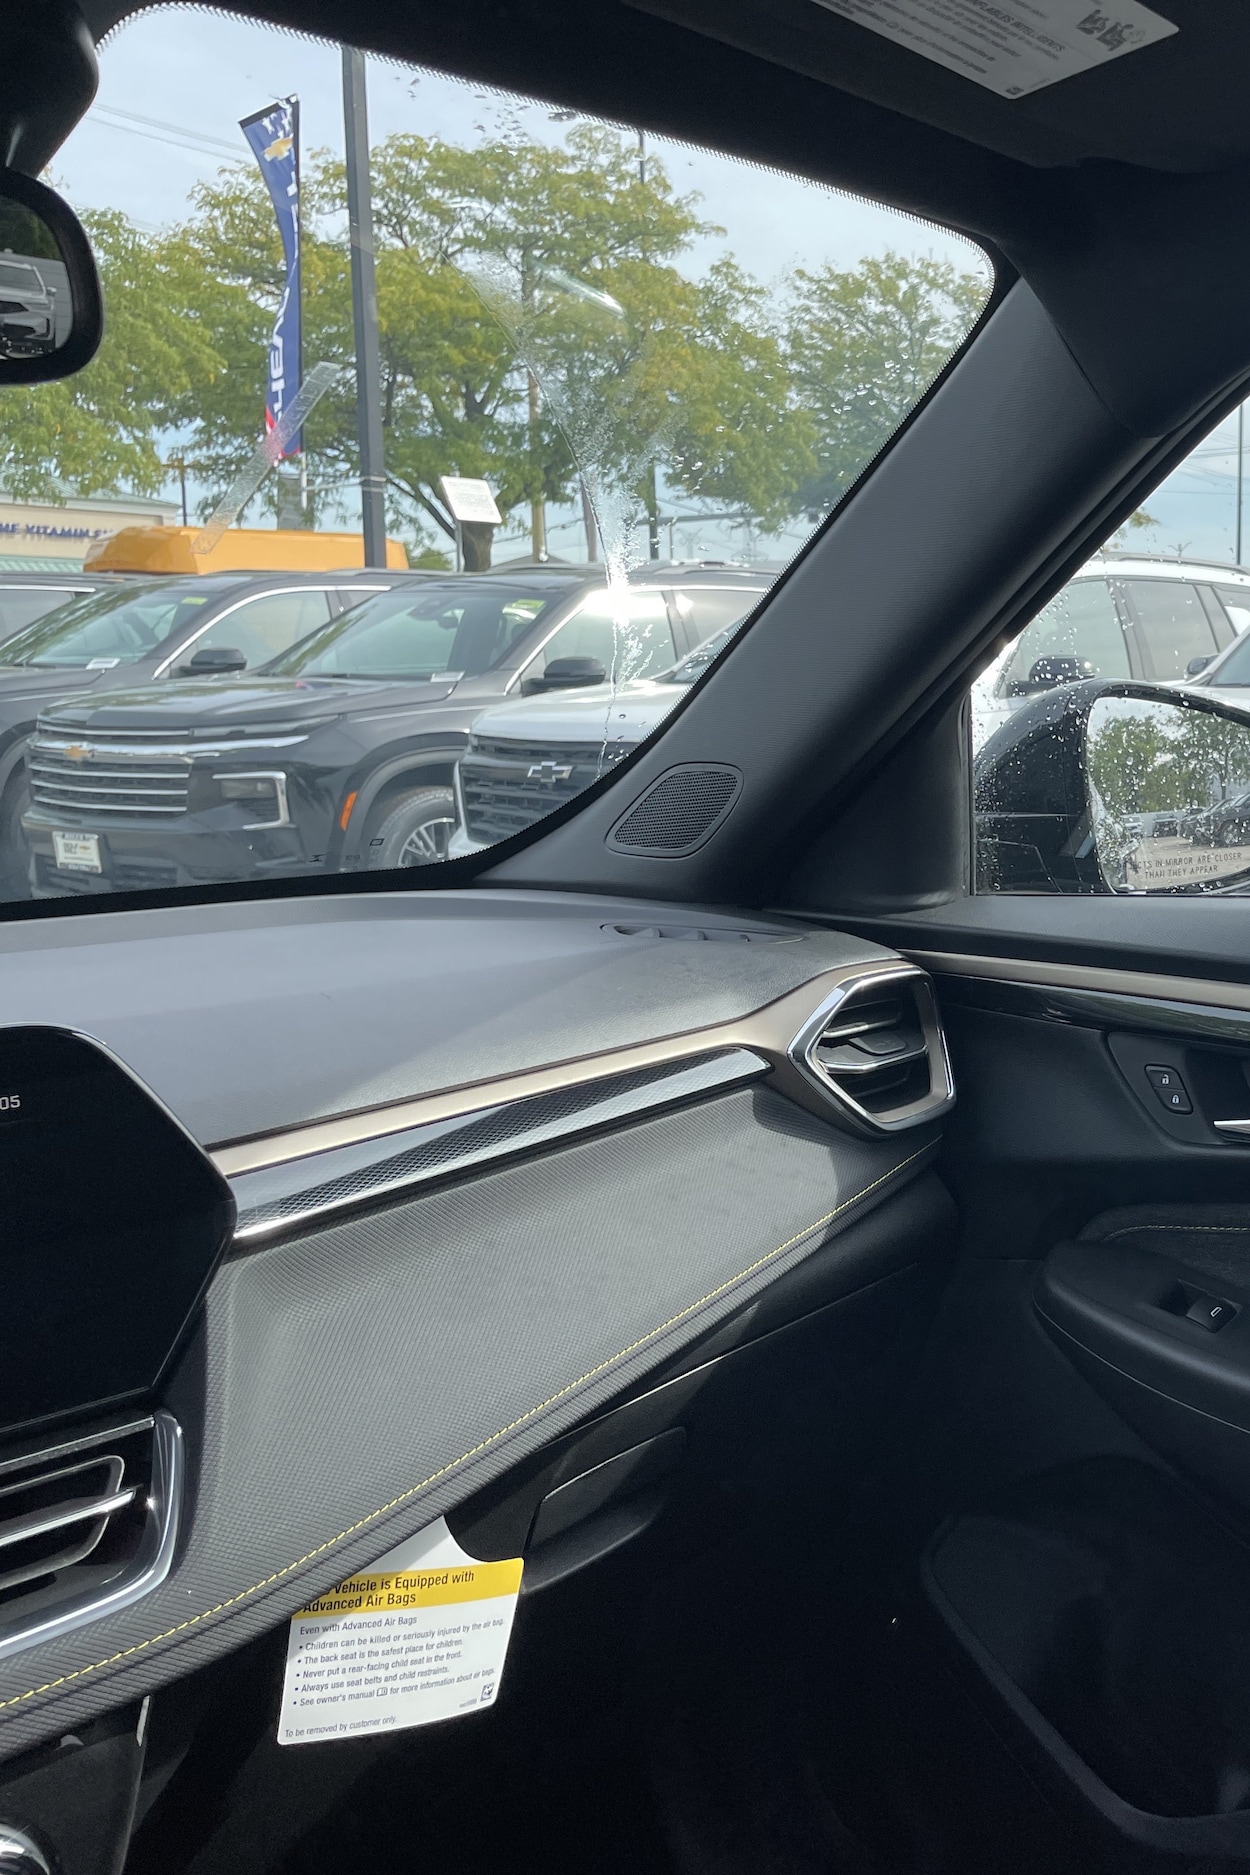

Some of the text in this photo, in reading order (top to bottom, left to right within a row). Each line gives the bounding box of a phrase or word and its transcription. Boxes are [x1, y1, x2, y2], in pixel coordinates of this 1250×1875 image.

[25, 524, 90, 538] VITAMIN
[1166, 857, 1193, 866] MIRROR
[1198, 854, 1210, 863] ARE
[1215, 853, 1241, 862] CLOSER
[1145, 865, 1218, 879] THAN THEY APPEAR
[335, 1580, 376, 1594] Vehicle
[381, 1578, 391, 1589] is
[395, 1573, 448, 1591] Equipped
[452, 1571, 474, 1583] with
[303, 1594, 416, 1613] Advanced Air Bags
[300, 1617, 417, 1635] Even with Advanced Air Bags
[306, 1640, 338, 1650] Children
[341, 1639, 355, 1647] can
[370, 1635, 390, 1644] killed
[403, 1629, 435, 1640] seriously
[437, 1626, 460, 1636] injured
[463, 1624, 470, 1633] by
[472, 1622, 481, 1630] the
[304, 1656, 318, 1664] The
[321, 1654, 338, 1663] back
[341, 1652, 357, 1660] seat
[368, 1648, 379, 1657] the
[381, 1647, 403, 1656] safest
[405, 1645, 423, 1655] place
[436, 1639, 463, 1649] children.
[303, 1670, 324, 1679] Never
[327, 1667, 339, 1677] put
[348, 1660, 389, 1673] rear-facing
[391, 1659, 408, 1668] child
[410, 1657, 424, 1665] seat
[446, 1651, 462, 1659] front.
[300, 1698, 314, 1706] See
[317, 1694, 346, 1705] owner's
[348, 1690, 375, 1700] manual
[390, 1687, 399, 1695] for
[401, 1684, 418, 1693] more
[420, 1677, 455, 1690] information
[456, 1673, 472, 1683] about
[301, 1682, 328, 1692] Always
[347, 1678, 362, 1687] seat
[365, 1676, 382, 1685] belts
[384, 1674, 397, 1683] and
[399, 1671, 415, 1680] child
[418, 1666, 449, 1677] restraints.
[285, 1729, 293, 1737] To
[307, 1724, 337, 1735] removed
[339, 1723, 347, 1732] by
[349, 1718, 381, 1729] customer
